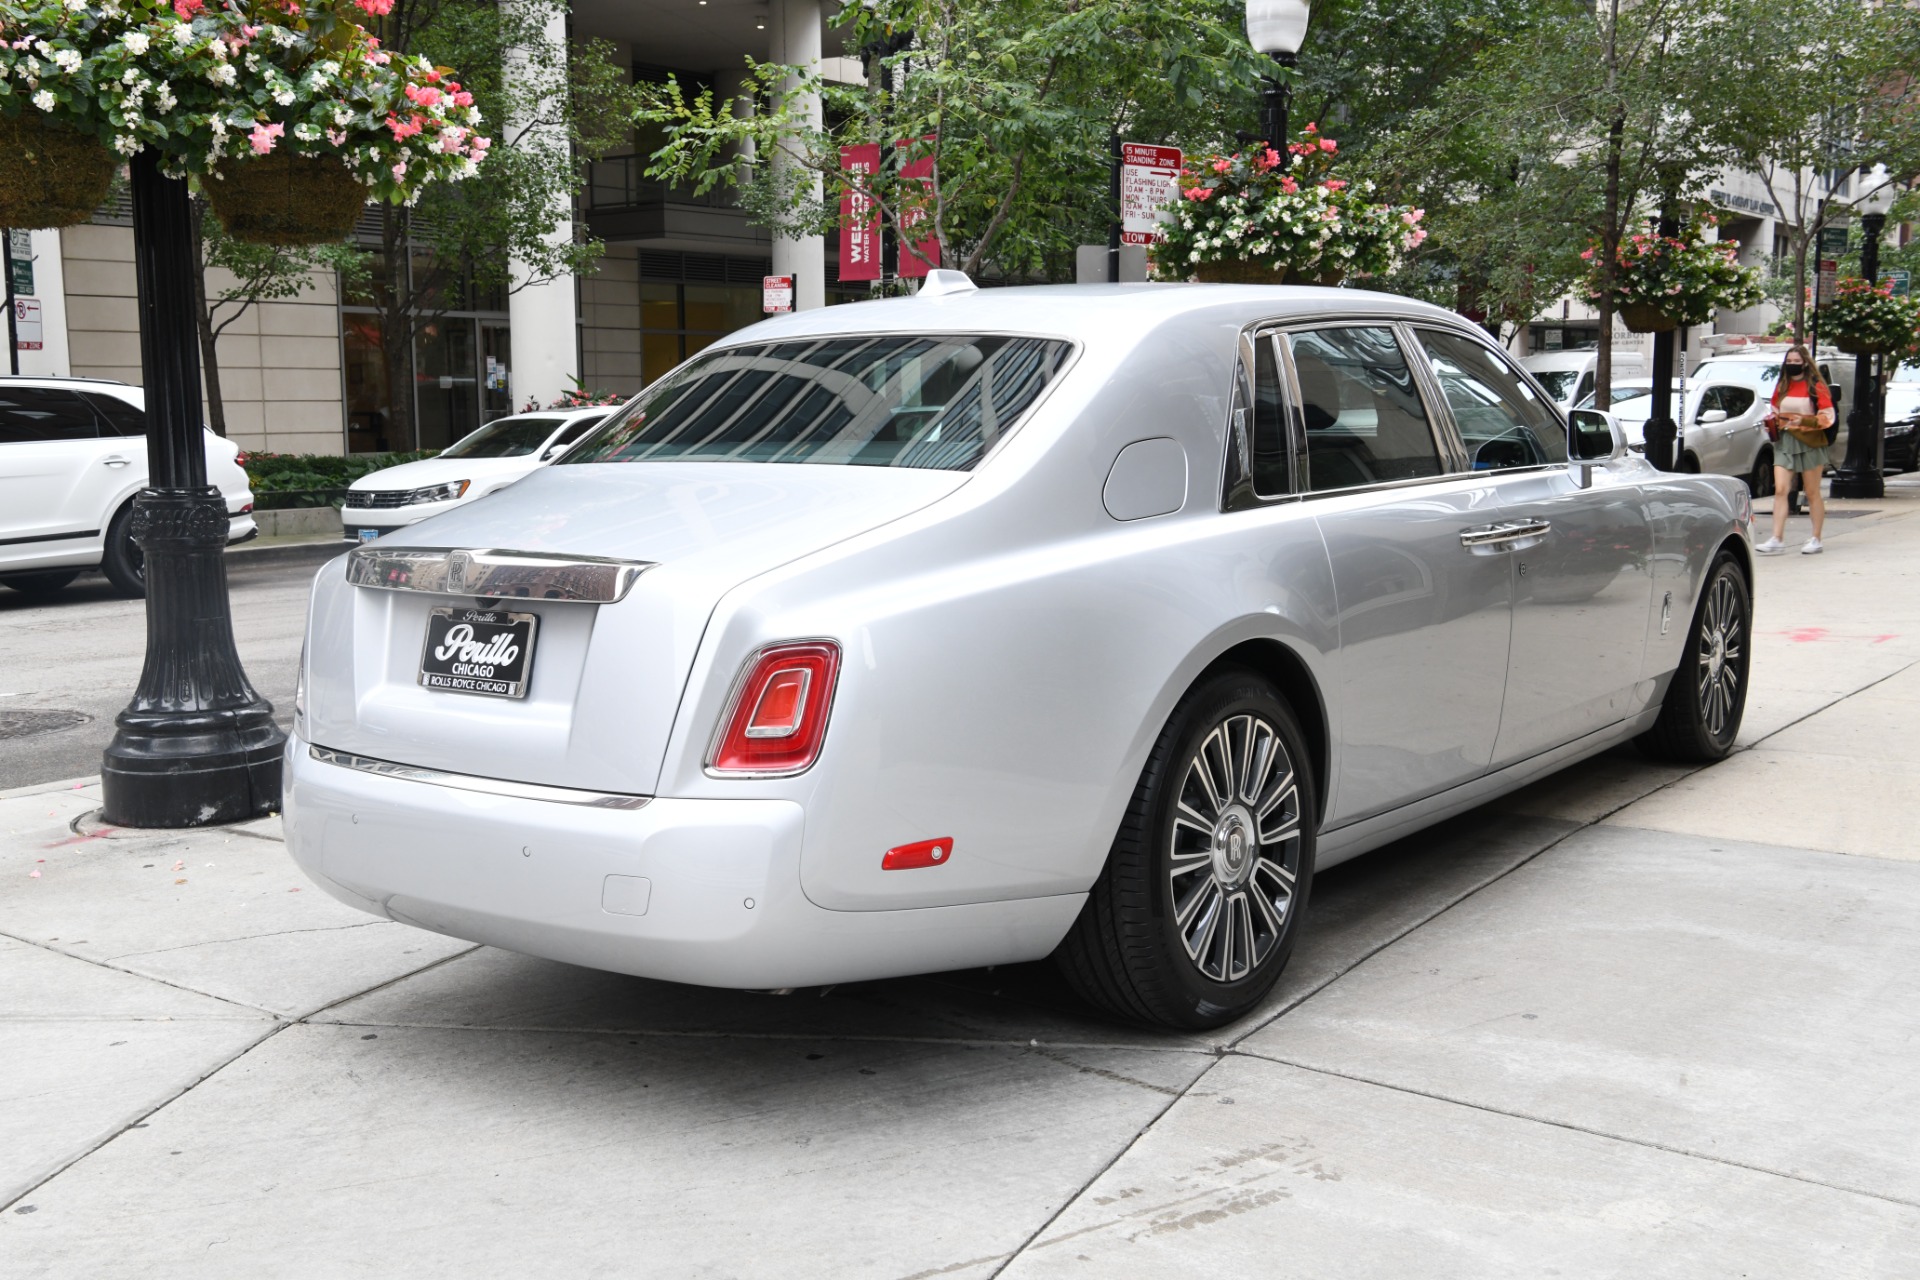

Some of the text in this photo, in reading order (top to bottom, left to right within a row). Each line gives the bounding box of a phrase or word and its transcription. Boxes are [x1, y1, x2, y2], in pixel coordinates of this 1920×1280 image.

[1135, 147, 1157, 157] MINUTE
[1126, 155, 1175, 167] STANDING ZONE
[1125, 177, 1172, 188] FLASHING LIGH
[1134, 186, 1143, 194] AM
[1155, 188, 1165, 196] PM
[1141, 212, 1155, 220] SUN
[1125, 232, 1168, 245] TOW ZON
[1613, 331, 1645, 339] ORBOY
[462, 610, 497, 622] Perillo
[435, 623, 519, 667] Perillo
[452, 662, 494, 678] CHICAGO
[430, 676, 507, 693] ROLLS ROYCE CHICAGO
